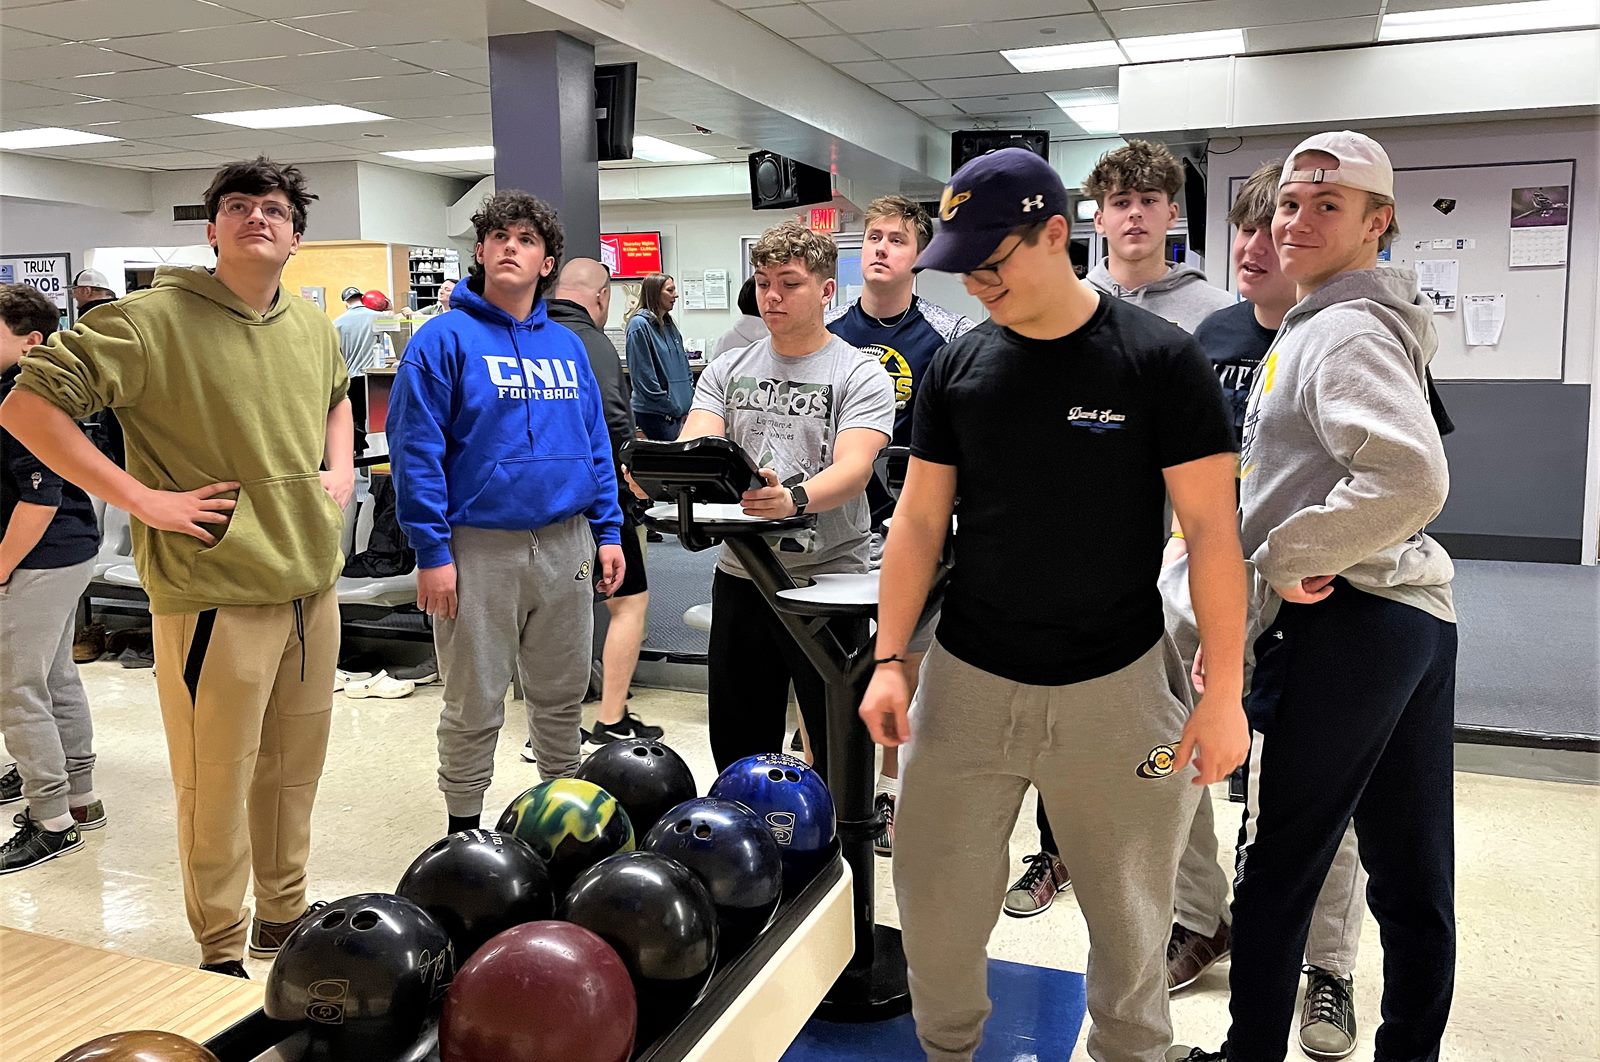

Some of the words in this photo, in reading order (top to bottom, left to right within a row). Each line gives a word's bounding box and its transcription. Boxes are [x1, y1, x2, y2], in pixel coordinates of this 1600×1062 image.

[811, 209, 836, 230] EXIT
[23, 260, 56, 273] TRULY
[482, 355, 578, 388] CNU
[498, 387, 579, 400] FOOTBALL
[726, 378, 829, 417] adidas
